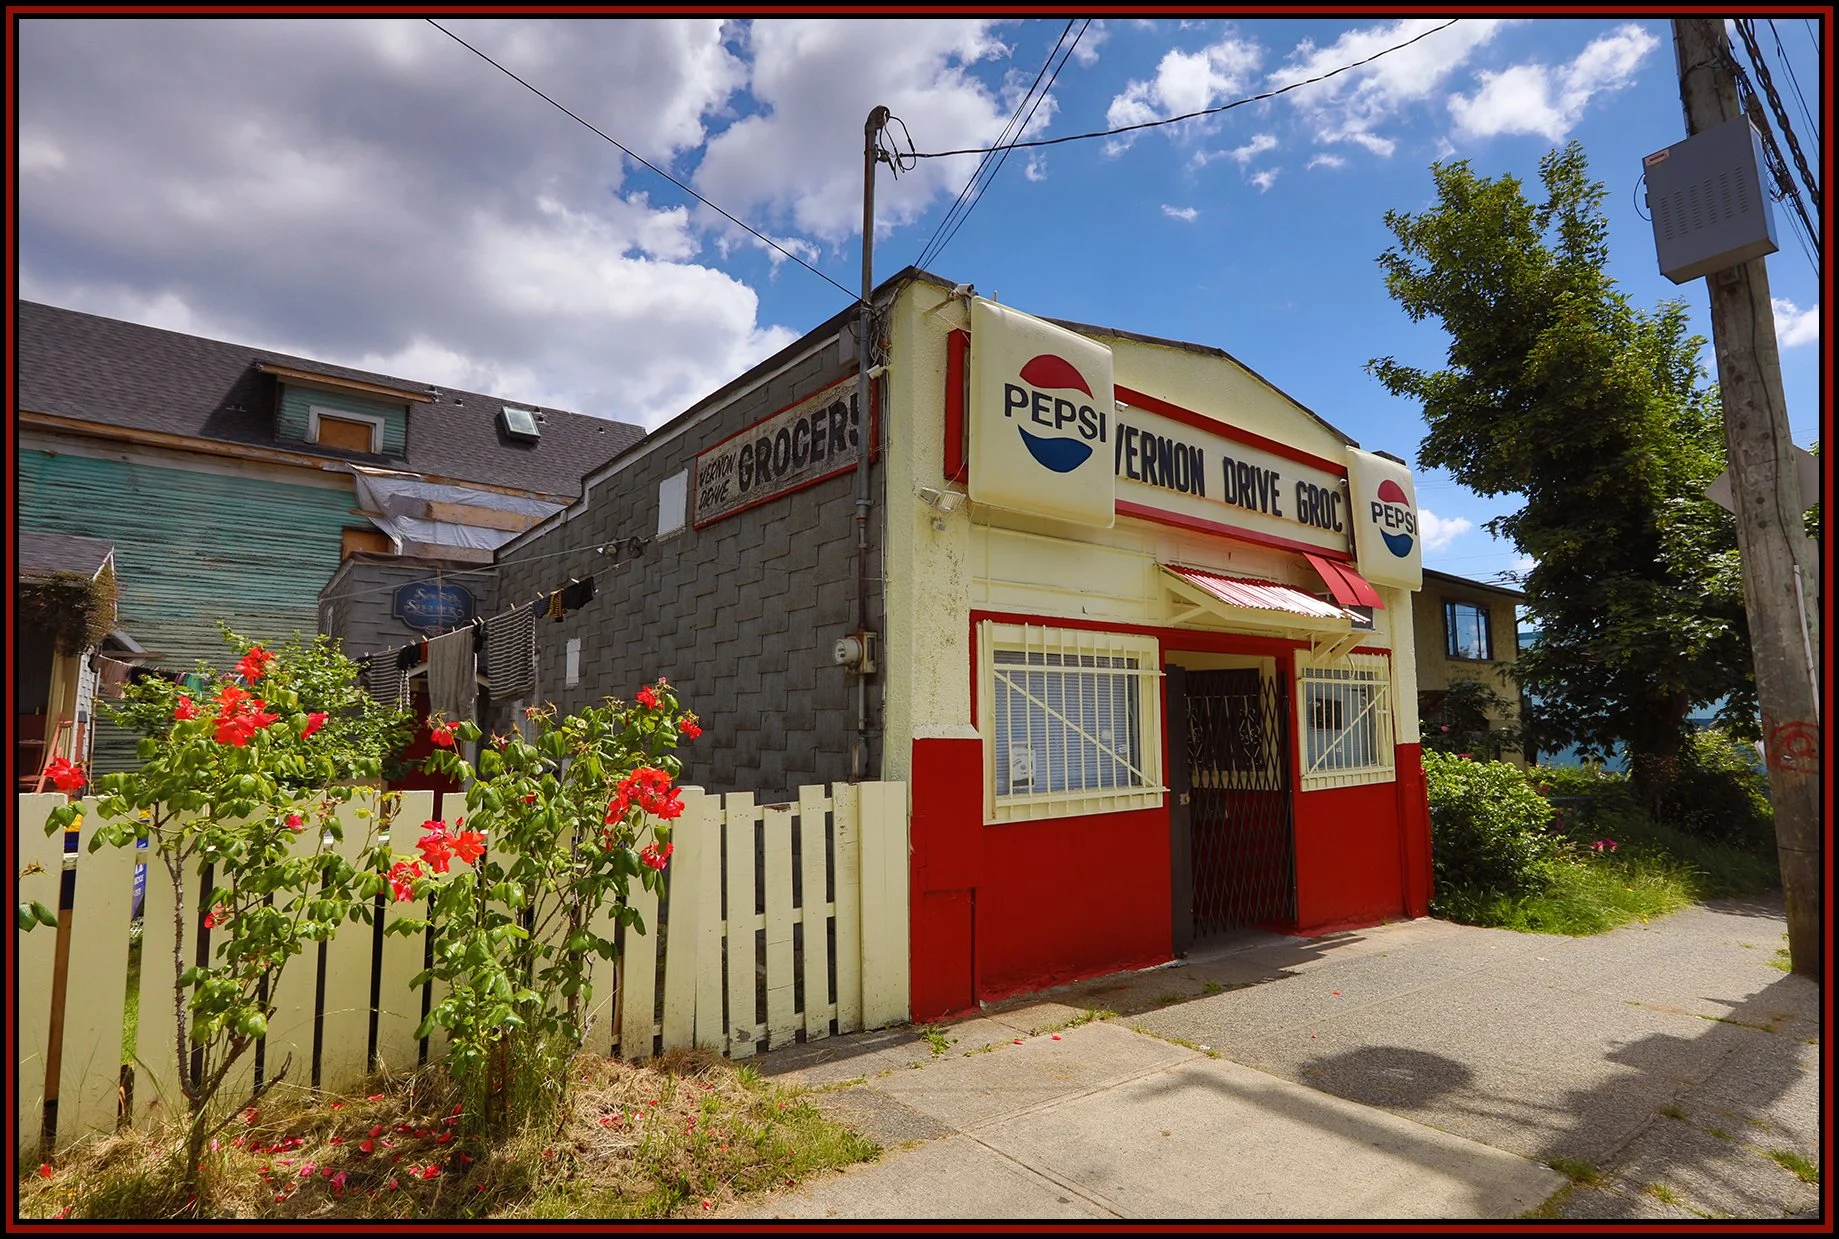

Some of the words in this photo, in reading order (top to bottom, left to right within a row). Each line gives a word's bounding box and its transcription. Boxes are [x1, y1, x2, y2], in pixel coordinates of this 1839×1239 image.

[1004, 382, 1107, 443] PEPSI
[699, 451, 737, 487] VERNON
[698, 478, 730, 511] DRIVE
[1223, 455, 1283, 517] DRIVE
[1296, 479, 1343, 533] GROC
[1370, 500, 1418, 536] PEPSI
